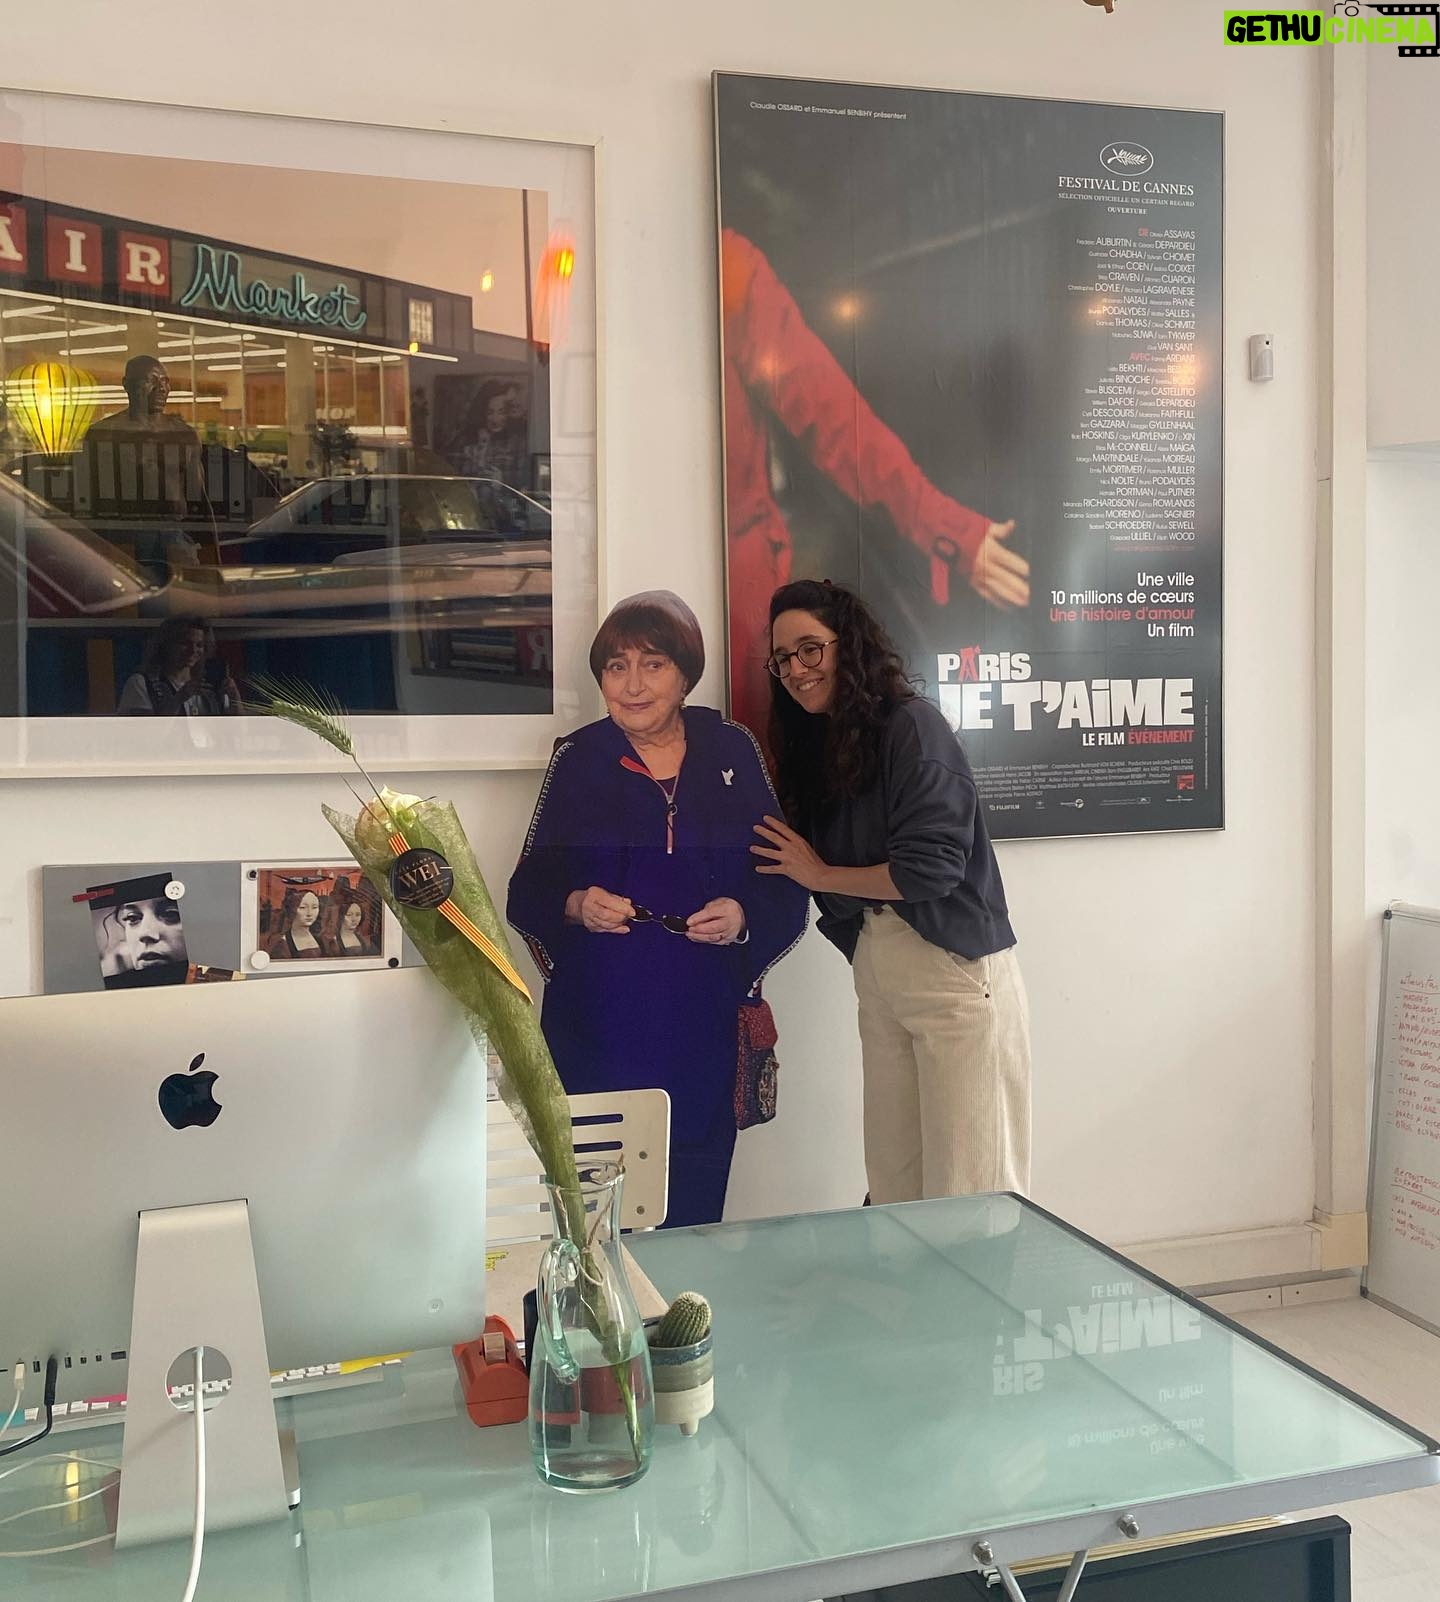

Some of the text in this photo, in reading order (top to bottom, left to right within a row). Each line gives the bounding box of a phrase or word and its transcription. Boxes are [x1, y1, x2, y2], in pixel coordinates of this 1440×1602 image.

[812, 106, 846, 115] Emmanuel
[1058, 176, 1194, 196] FESTIVAL DE CANNES
[1094, 194, 1128, 203] OFFICIELLE
[1164, 230, 1195, 239] ASSAYAS
[1096, 237, 1131, 247] AUBURTIN
[1155, 241, 1195, 250] DEPARDIEU
[1109, 249, 1142, 259] CHADHA
[1163, 252, 1195, 261] CHOMET
[1126, 262, 1150, 271] COEN
[1168, 264, 1195, 273] COIXET
[1109, 272, 1140, 282] CRAVEN
[181, 244, 366, 332] Market
[1095, 283, 1120, 292] DOYLE
[1143, 286, 1195, 295] LAGRAVENESE
[1123, 296, 1147, 304] NATALI
[1172, 298, 1195, 306] PAYNE
[1165, 309, 1189, 318] SALLES
[1115, 318, 1148, 327] THOMAS
[1165, 320, 1195, 329] SCHMITZ
[1133, 330, 1153, 339] SUWA
[1168, 331, 1195, 340] TYKWER
[1175, 343, 1193, 351] SANT
[1116, 376, 1150, 384] BINOCHE
[1099, 386, 1132, 395] BUSCEMI
[1108, 397, 1134, 406] DAFOE
[1156, 399, 1195, 407] DEPARDIEU
[1093, 409, 1134, 417] DESCOURS
[1161, 410, 1194, 418] FAITHFULL
[1090, 420, 1125, 428] GAZZARA
[1149, 421, 1194, 429] GYLLENHAAL
[1082, 431, 1114, 440] HOSKINS
[1132, 432, 1174, 440] KURYLENKO
[1092, 454, 1138, 462] MARTINDALE
[1163, 455, 1195, 463] MOREAU
[1103, 465, 1142, 473] MORTIMER
[1117, 488, 1153, 496] PORTMAN
[1169, 488, 1195, 496] PUTNER
[1083, 499, 1134, 507] RICHARDSON
[1153, 499, 1195, 507] ROWLANDS
[1106, 510, 1140, 518] MORENO
[1164, 510, 1195, 518] SAGNIER
[1105, 521, 1151, 529] SCHROEDER
[1169, 521, 1194, 529] SEWELL
[1169, 532, 1194, 540] WOOD
[1138, 572, 1194, 586] Une ville
[1051, 590, 1194, 604] 10 millions de cœurs
[1050, 607, 1195, 621] Une histoire d'amour
[1148, 623, 1194, 637] Un film
[1083, 733, 1095, 746] LE
[1099, 731, 1124, 745] FILM
